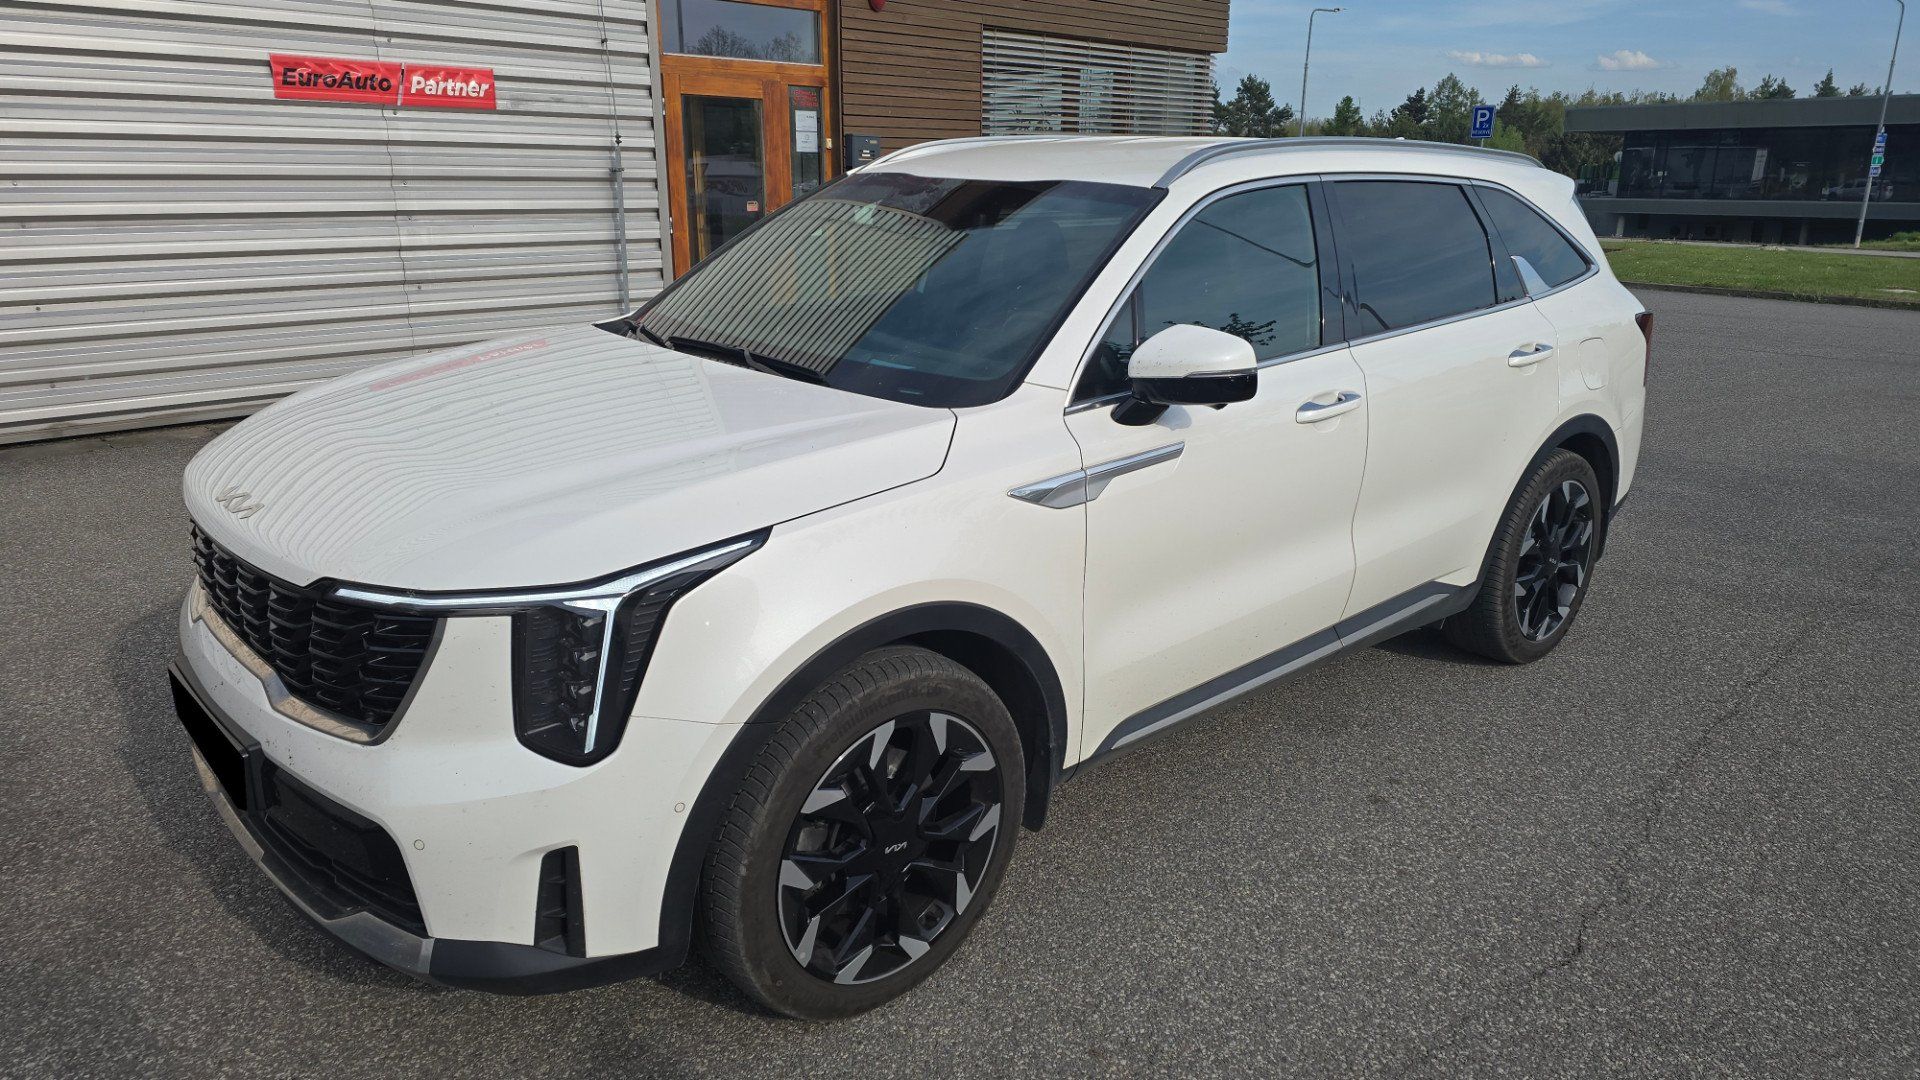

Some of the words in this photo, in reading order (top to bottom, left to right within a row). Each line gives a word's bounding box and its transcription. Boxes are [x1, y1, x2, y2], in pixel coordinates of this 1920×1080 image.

[282, 67, 392, 92] EuroAuto
[410, 75, 490, 97] Partner
[1476, 109, 1490, 129] P
